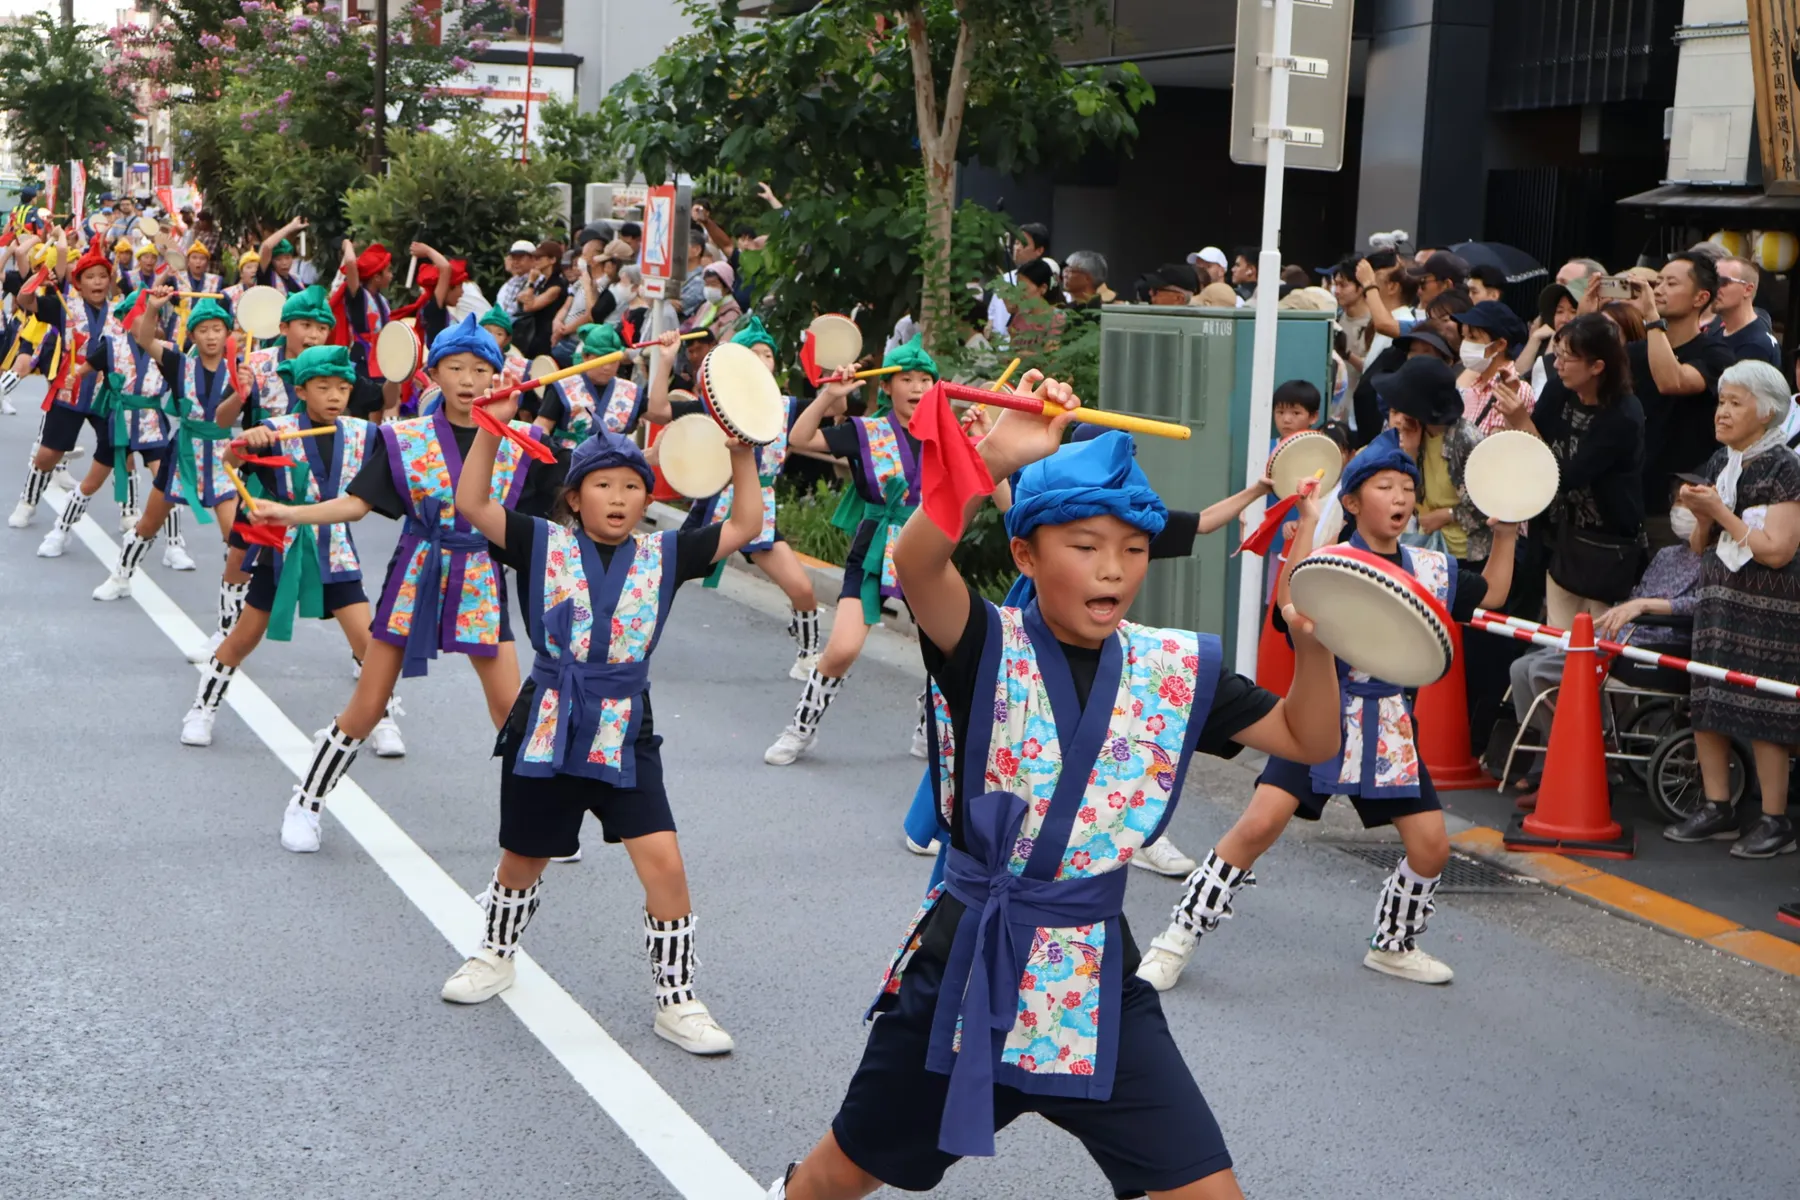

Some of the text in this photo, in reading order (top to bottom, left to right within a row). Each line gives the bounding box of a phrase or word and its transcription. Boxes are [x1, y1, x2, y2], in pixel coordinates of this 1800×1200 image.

[1769, 27, 1793, 174] 浅草国際通り店
